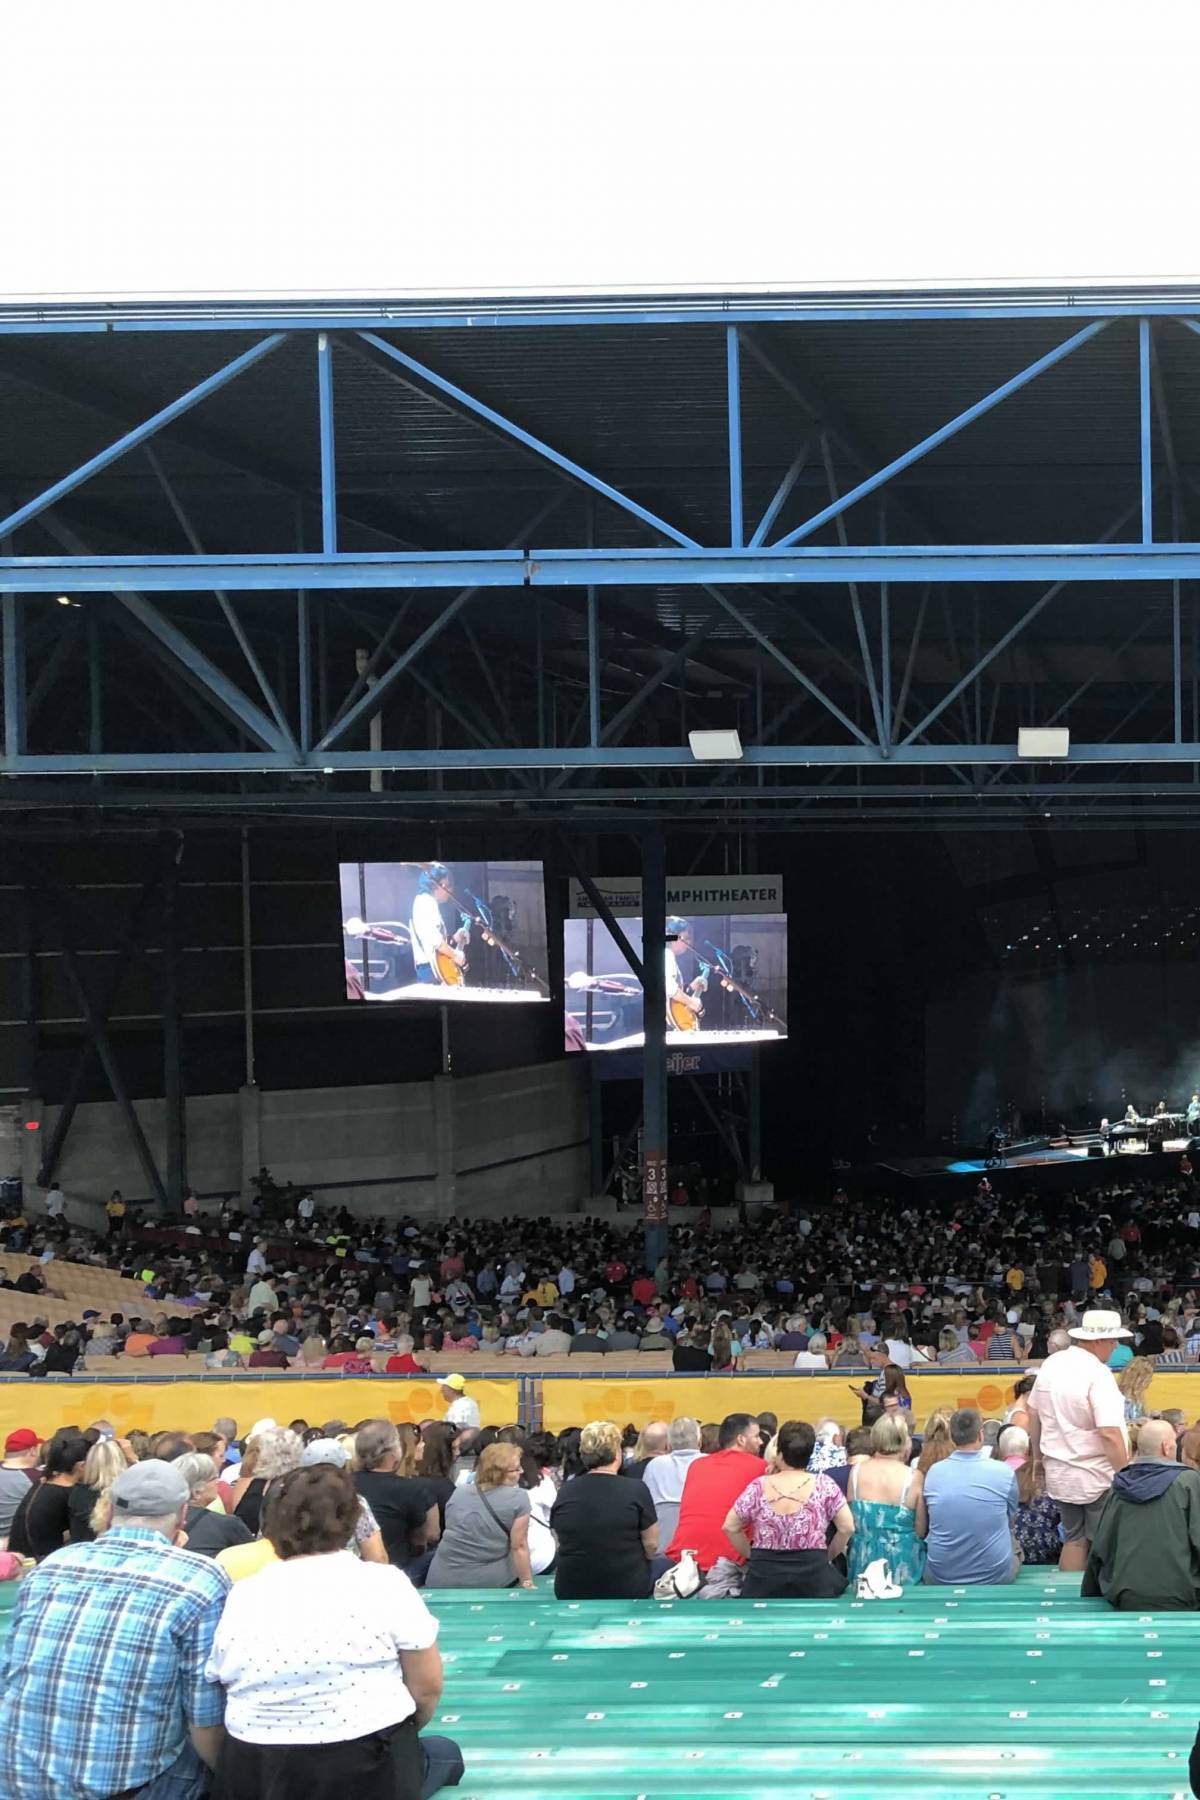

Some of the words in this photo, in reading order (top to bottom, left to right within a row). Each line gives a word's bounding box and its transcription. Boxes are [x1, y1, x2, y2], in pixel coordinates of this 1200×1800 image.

[666, 888, 777, 903] MPHITHEATER
[666, 1052, 701, 1075] eijer
[647, 1168, 656, 1181] 3
